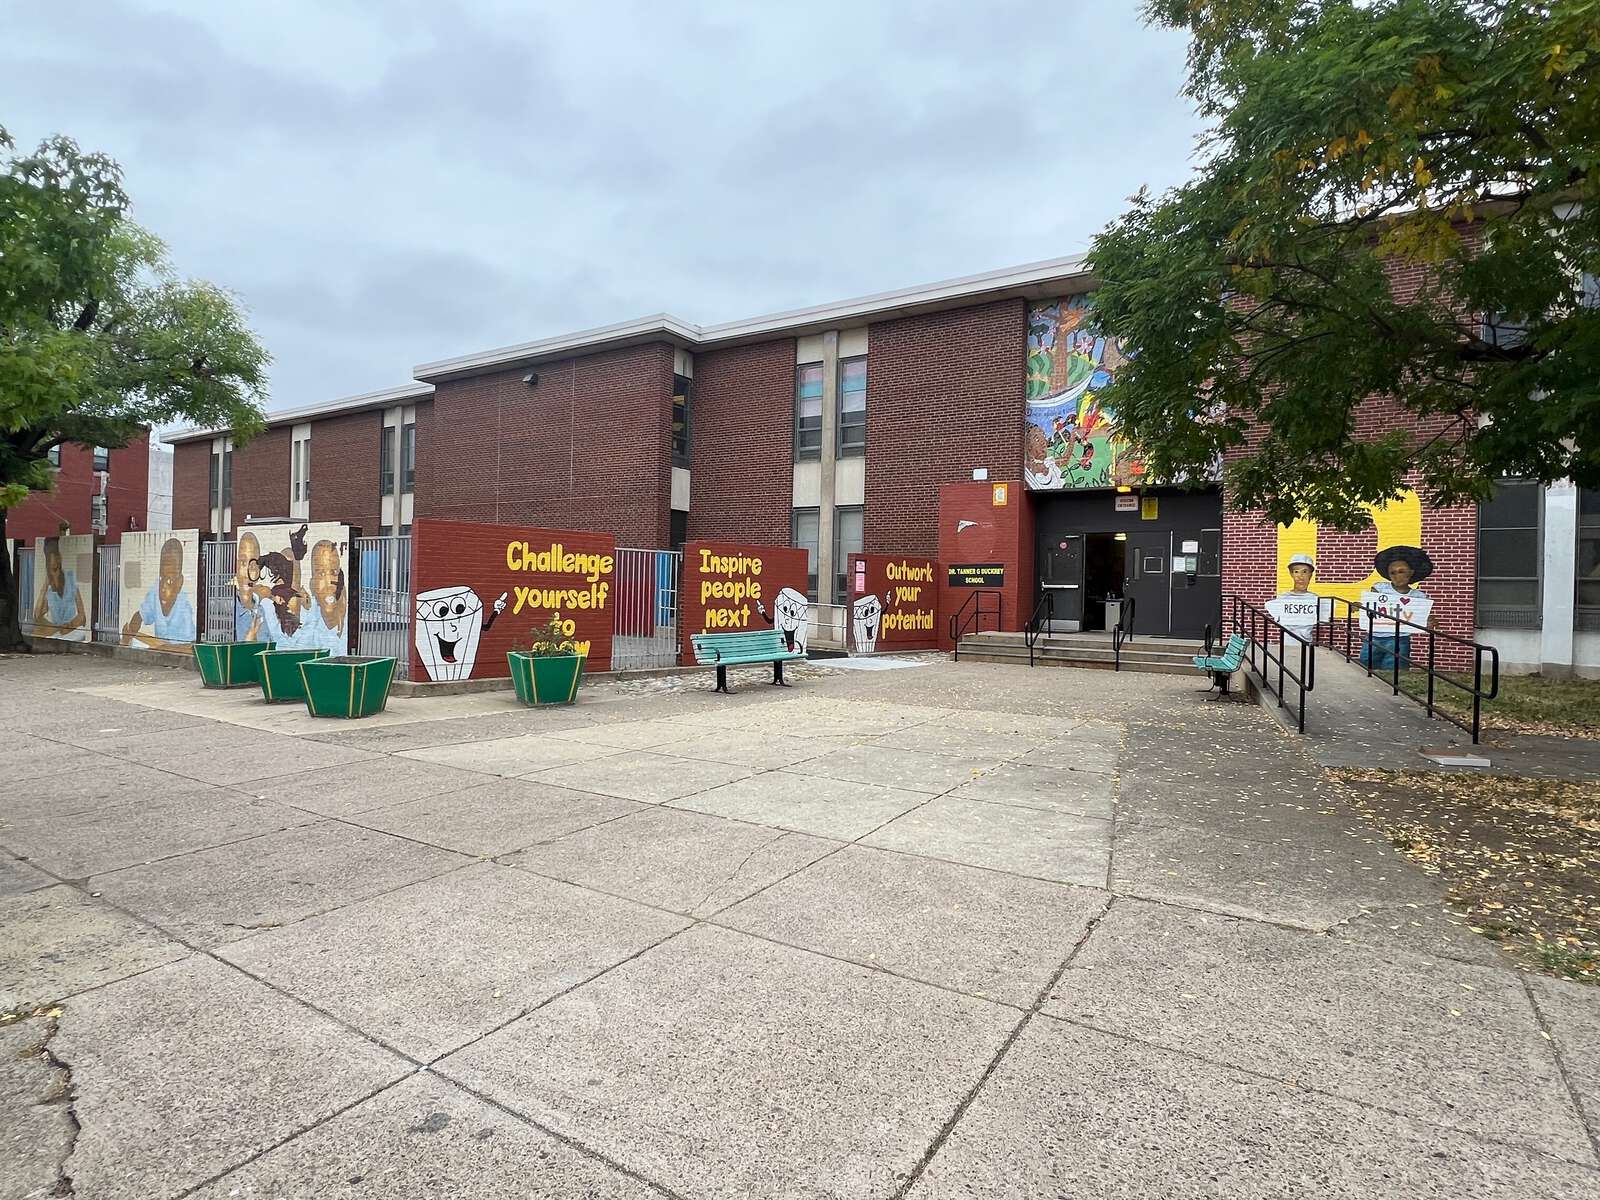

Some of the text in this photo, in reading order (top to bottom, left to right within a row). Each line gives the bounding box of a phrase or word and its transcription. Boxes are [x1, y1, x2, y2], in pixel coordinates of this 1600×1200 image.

[506, 540, 614, 583] Challenge
[699, 549, 762, 579] Inspire
[886, 561, 933, 583] Outwork
[512, 582, 609, 615] yourself
[701, 579, 762, 605] people
[894, 585, 922, 606] your
[705, 604, 751, 629] next
[881, 611, 934, 640] potential
